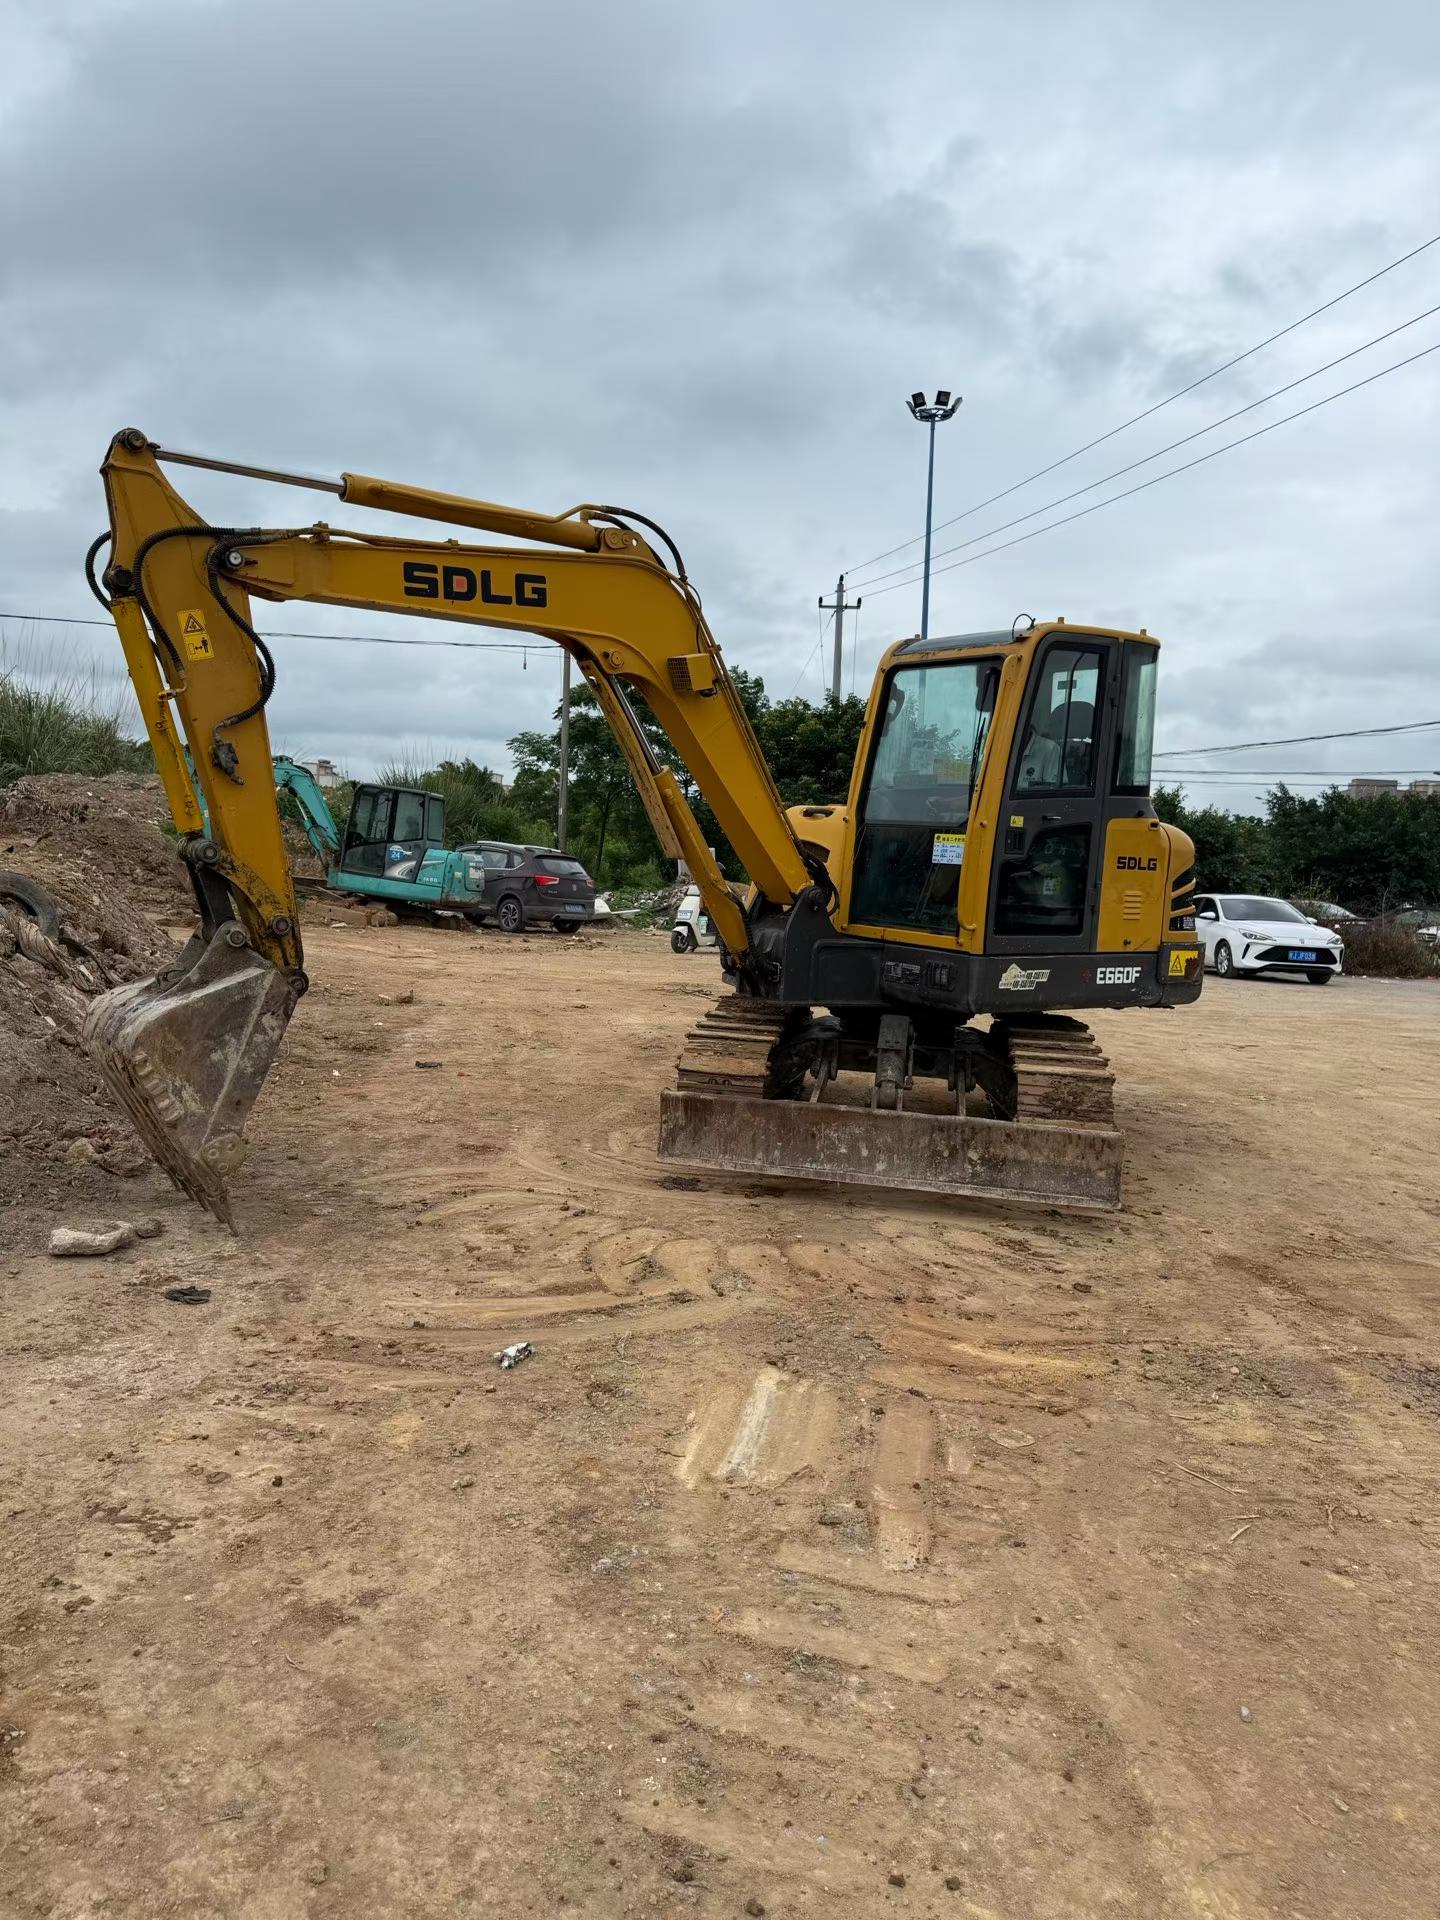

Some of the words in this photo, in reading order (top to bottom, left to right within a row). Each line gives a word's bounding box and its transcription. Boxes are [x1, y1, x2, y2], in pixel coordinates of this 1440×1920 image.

[404, 562, 547, 608] SDLG
[1117, 856, 1157, 871] SDLG
[1096, 967, 1142, 984] E660F
